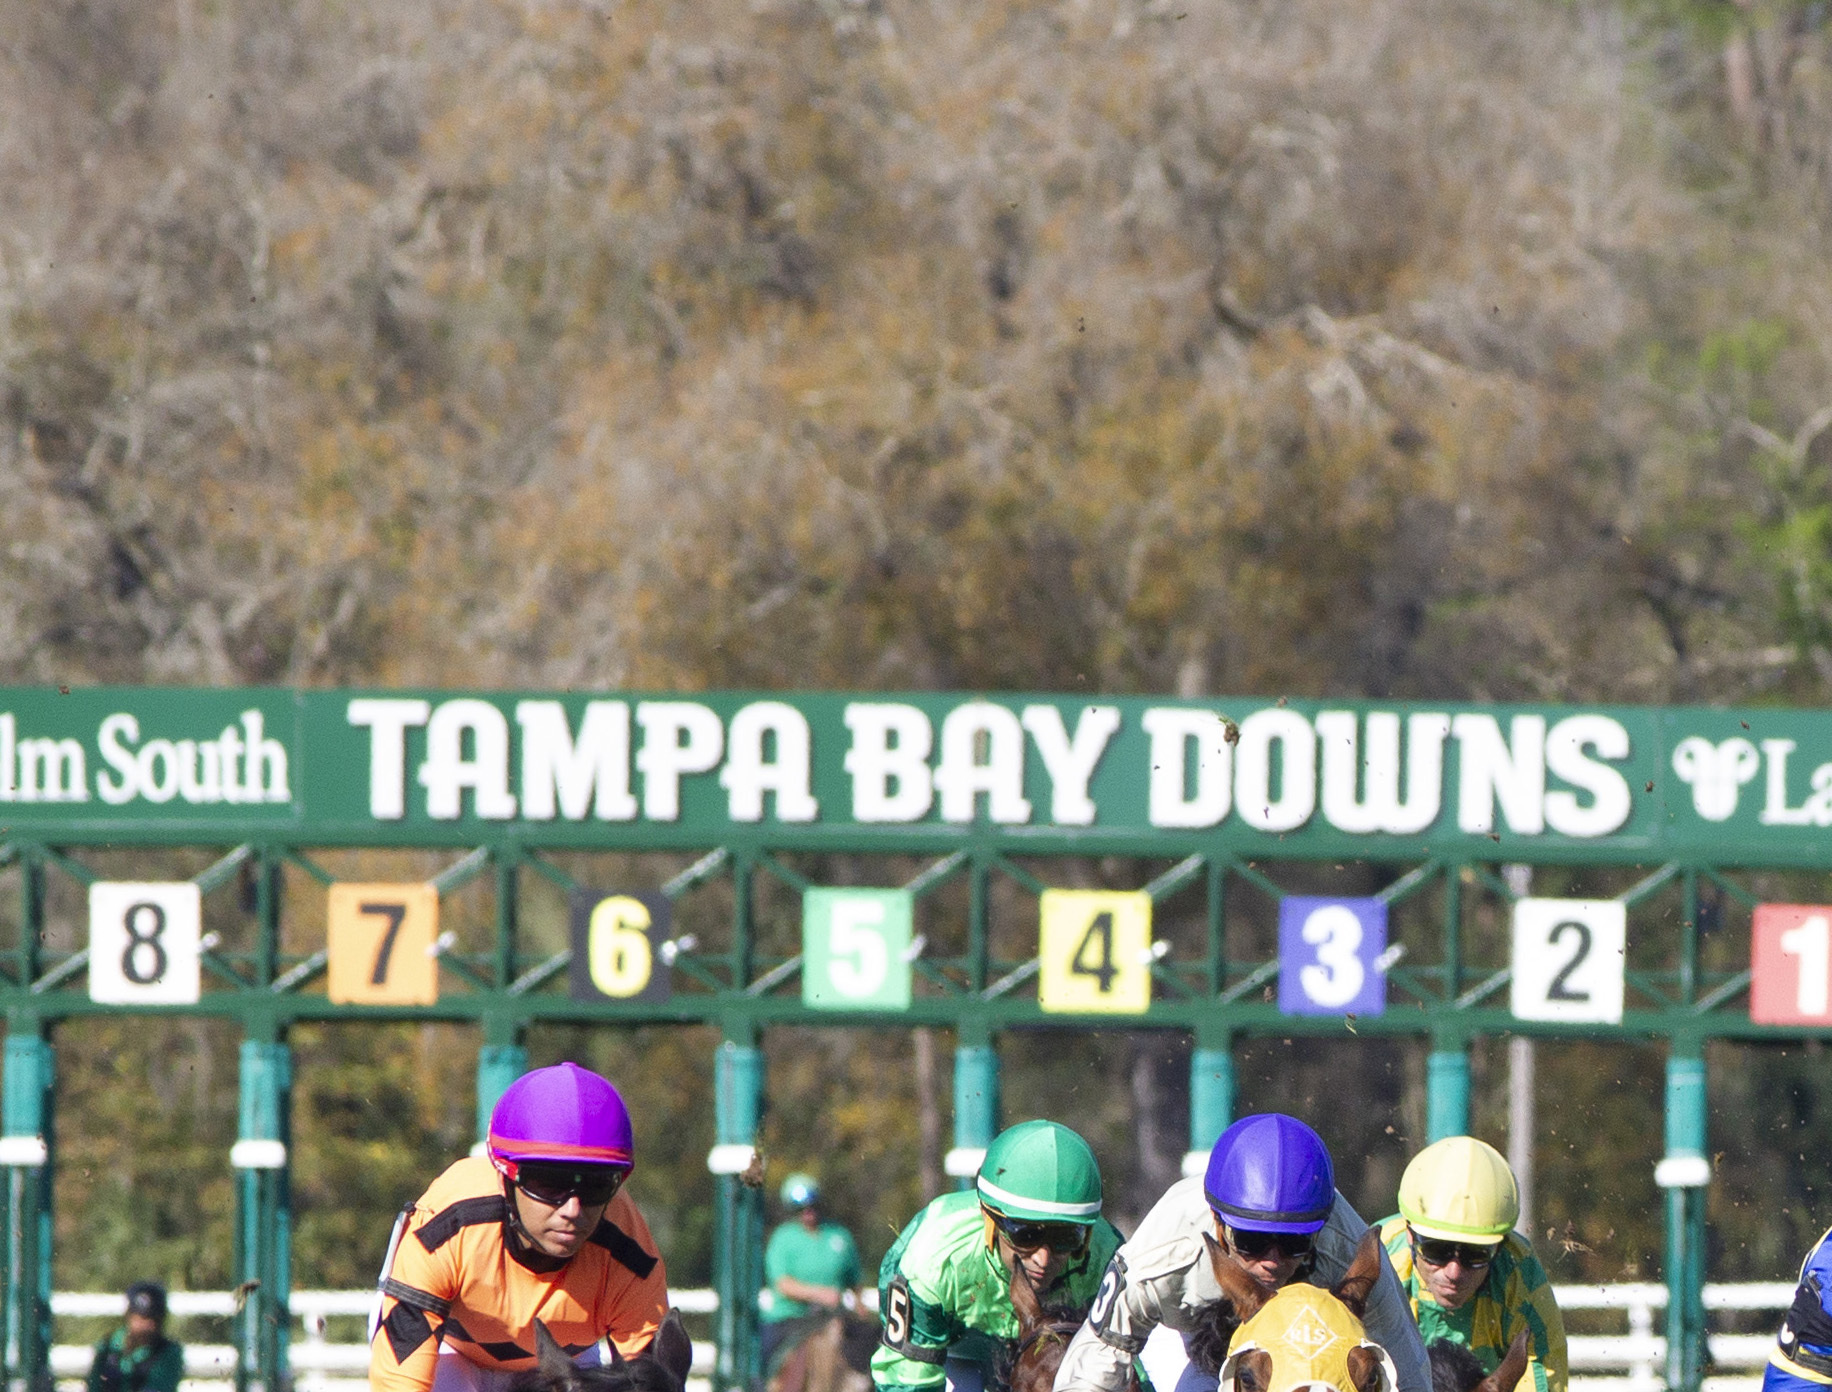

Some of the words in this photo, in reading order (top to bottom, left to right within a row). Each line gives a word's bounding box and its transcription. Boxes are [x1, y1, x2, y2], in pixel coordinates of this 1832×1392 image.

[96, 709, 290, 805] South
[347, 697, 818, 823] TAMPA
[844, 700, 1121, 827] BAY
[1141, 705, 1632, 838] DOWNS
[121, 902, 168, 985] 8
[358, 902, 408, 987] 7
[589, 894, 650, 998] 6
[826, 898, 890, 1000] 5
[1070, 911, 1120, 994] 4
[1301, 904, 1365, 1009] 3
[1545, 919, 1592, 1003] 2
[1779, 914, 1831, 1018] 1
[887, 1288, 907, 1343] 5
[1090, 1270, 1117, 1325] 3
